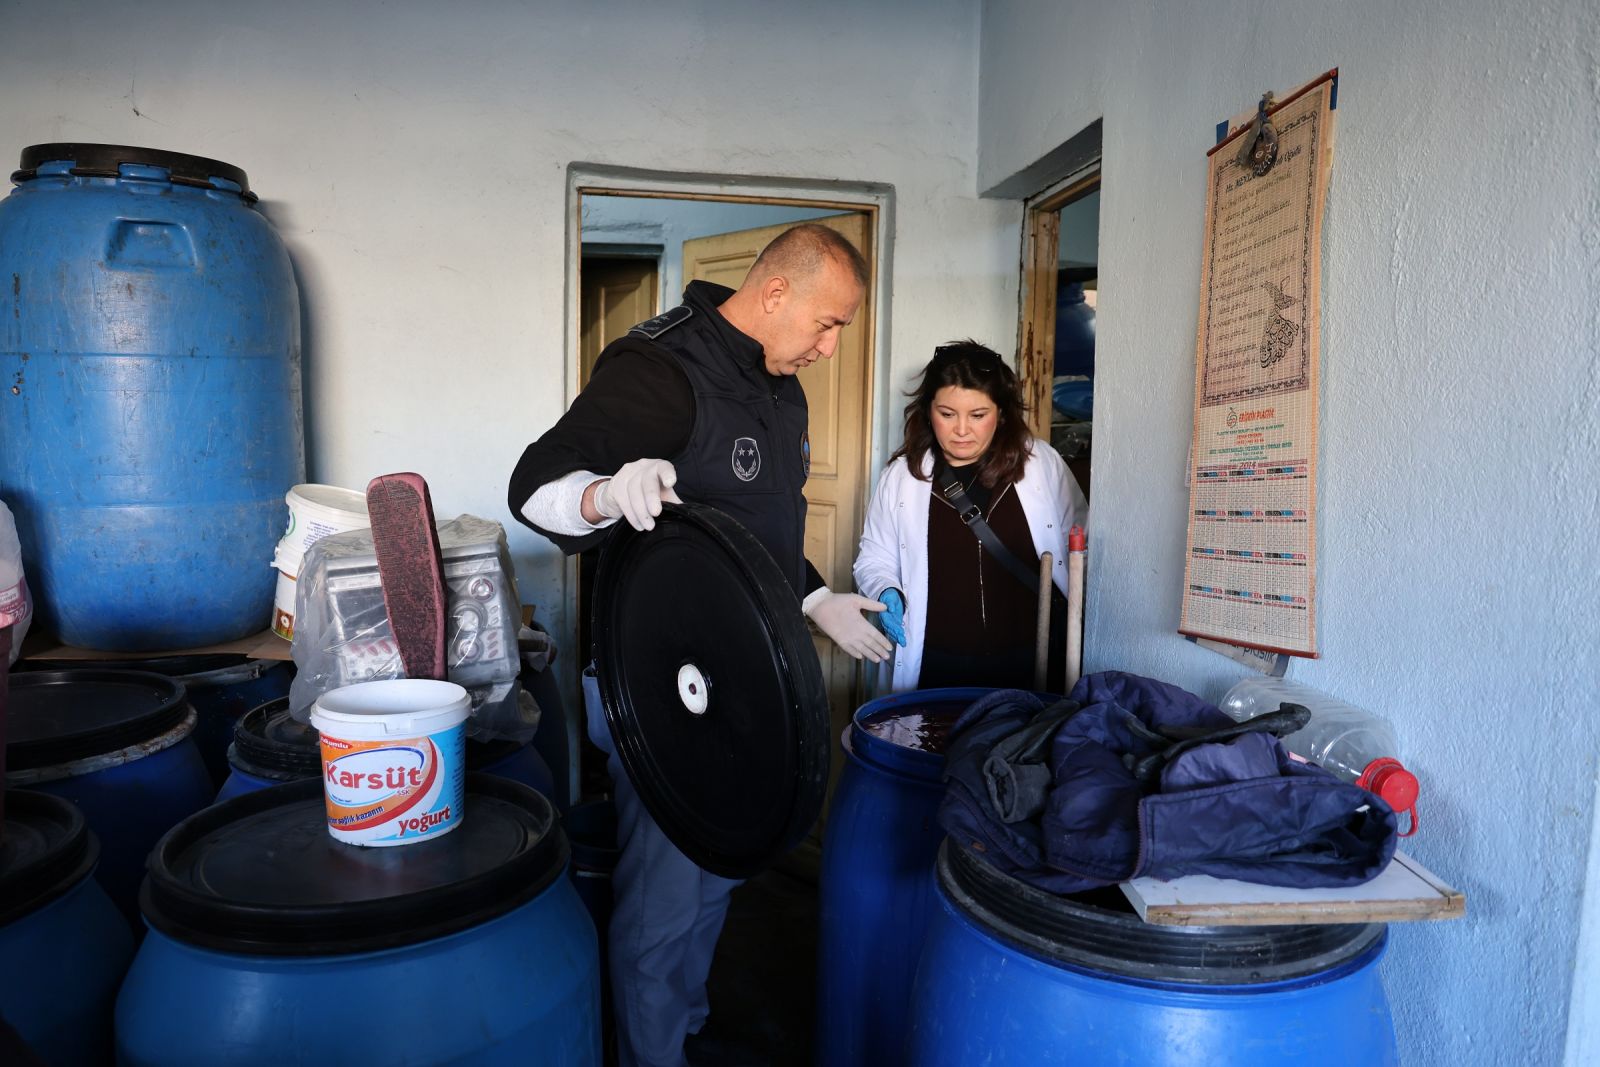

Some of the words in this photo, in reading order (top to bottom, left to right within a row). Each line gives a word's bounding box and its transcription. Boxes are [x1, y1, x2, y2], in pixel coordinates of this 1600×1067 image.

[1239, 461, 1257, 469] 2014
[324, 760, 422, 790] Karsüt
[355, 805, 385, 822] kazanın
[397, 805, 451, 836] yoğurt
